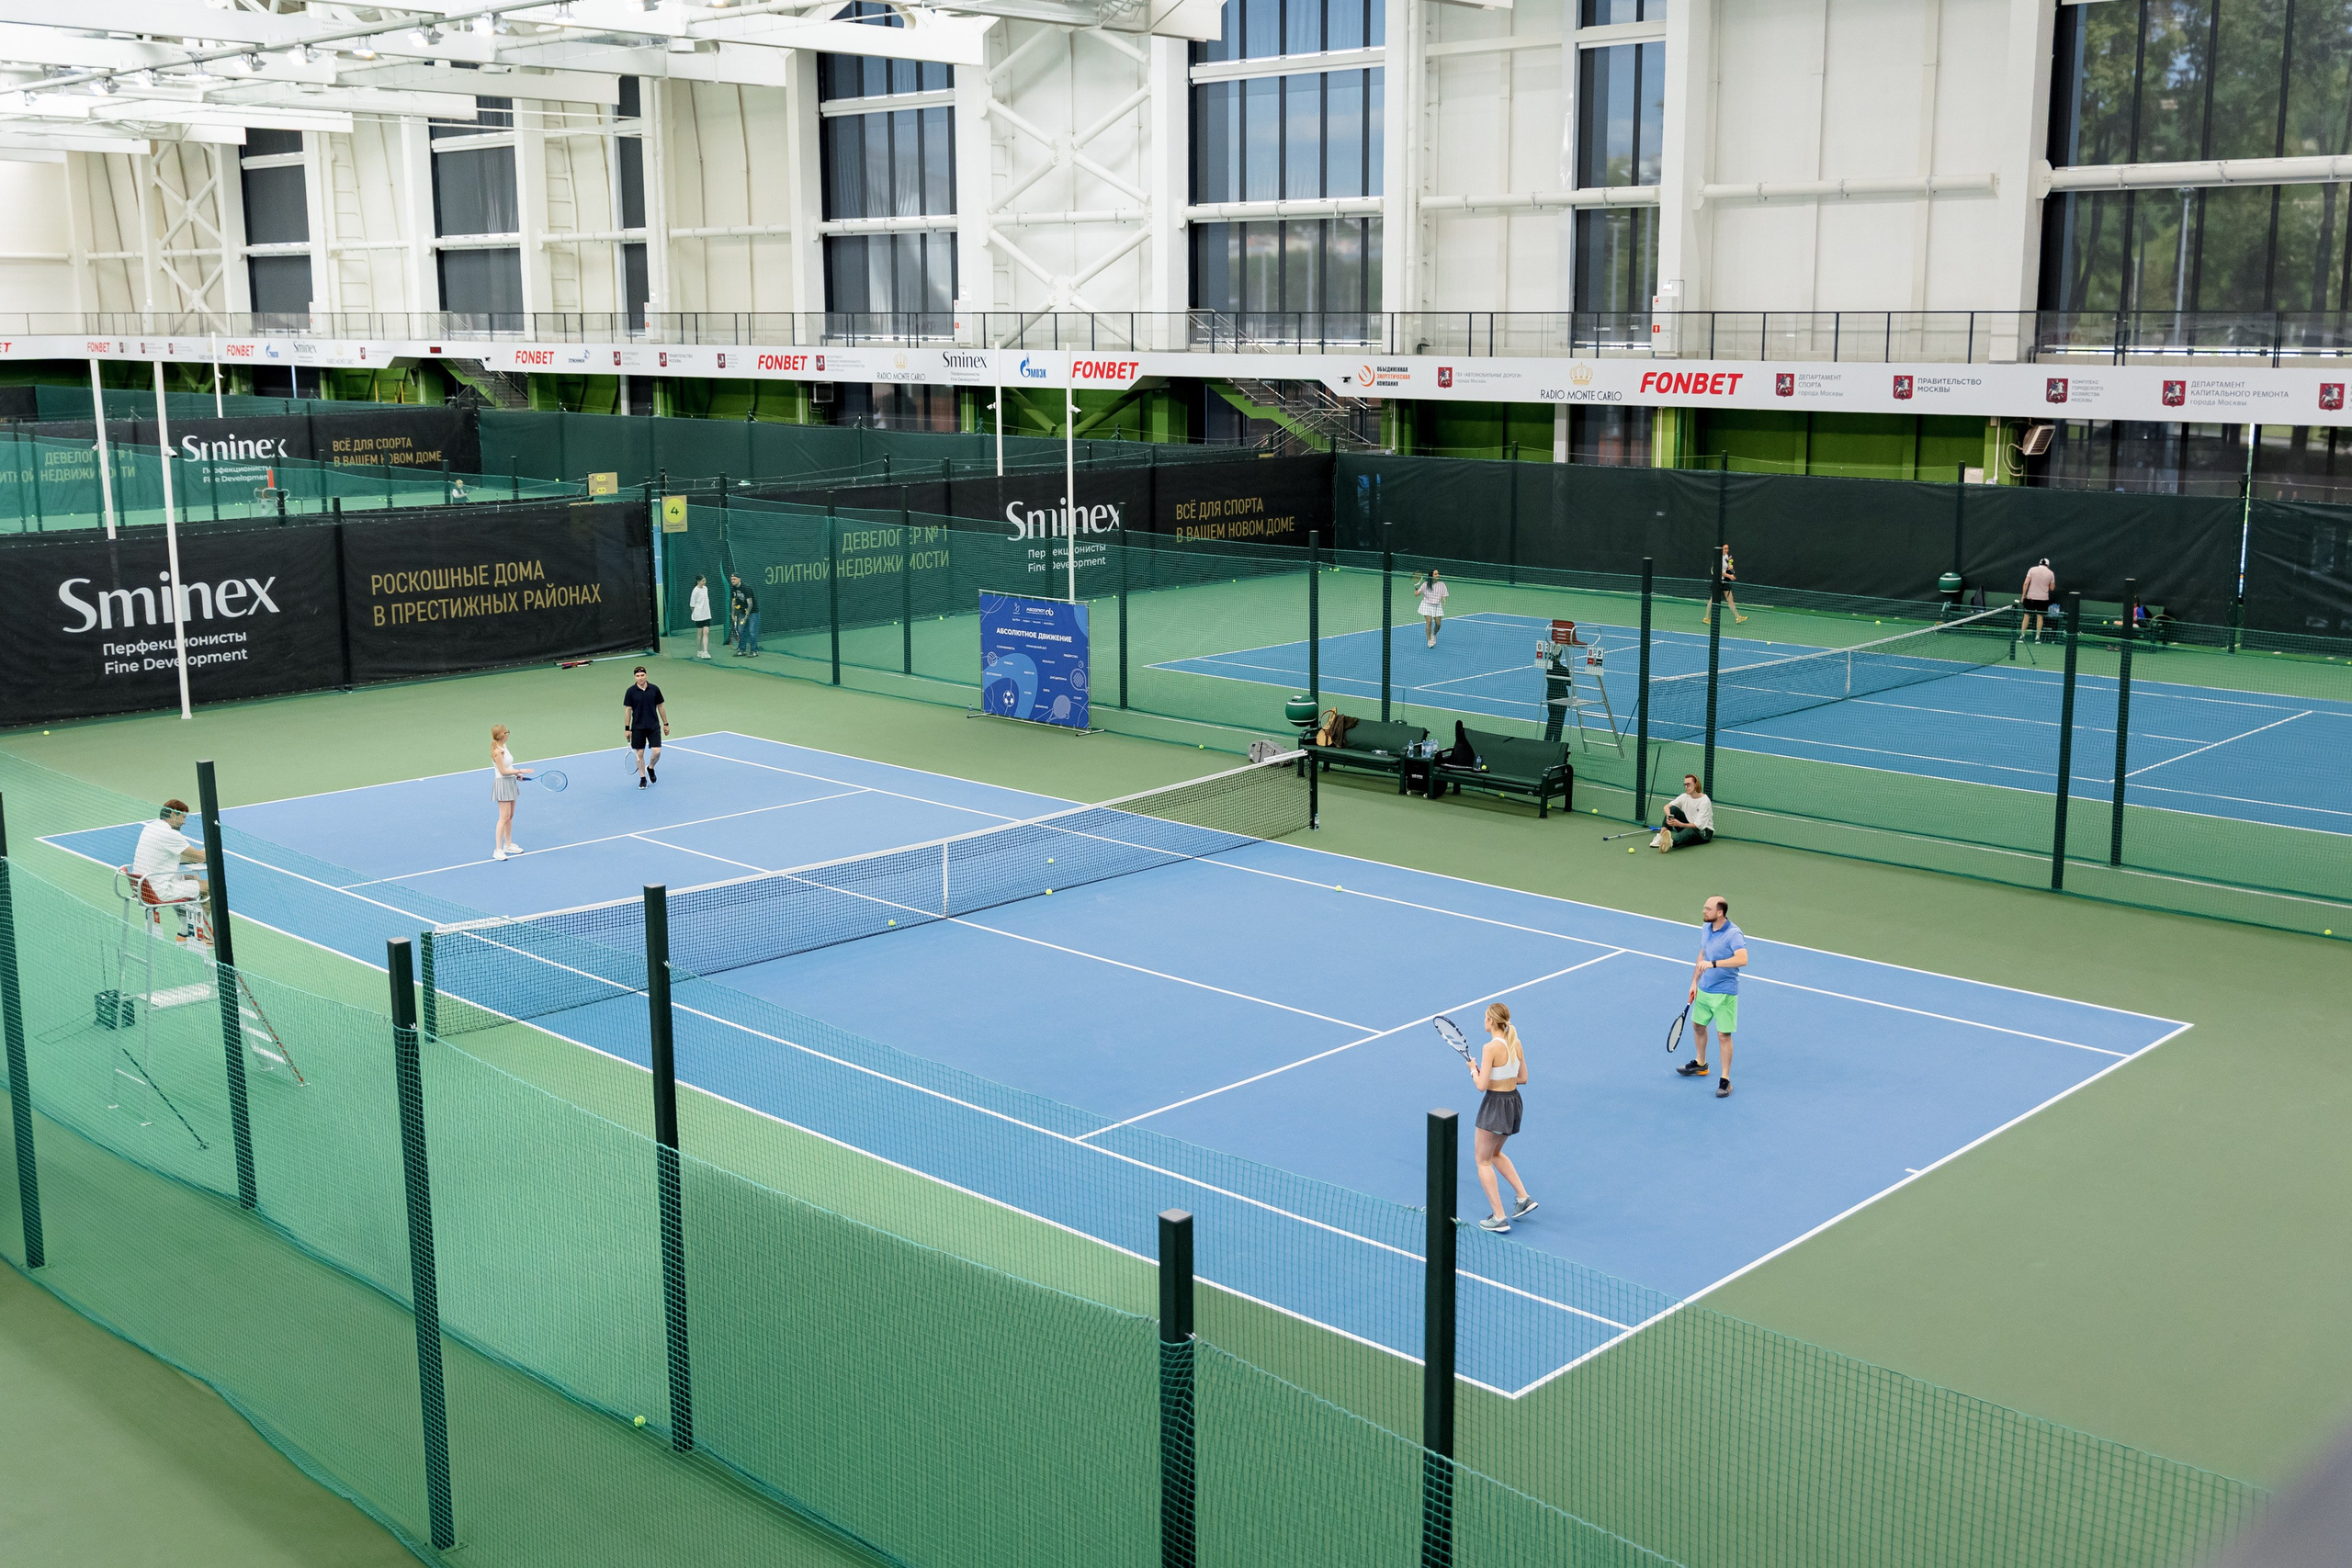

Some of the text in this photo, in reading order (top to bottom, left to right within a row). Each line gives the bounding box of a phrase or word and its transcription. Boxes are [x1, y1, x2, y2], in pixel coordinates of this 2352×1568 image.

[87, 342, 110, 353] FONBET
[226, 345, 254, 357] FONBET
[515, 350, 554, 365] FONBET
[758, 355, 808, 371] FONBET
[943, 351, 987, 368] Sminex
[877, 372, 925, 381] RADIO MONTE CARLO
[1072, 361, 1139, 380] FONBET
[1640, 372, 1743, 395] FONBET
[1540, 389, 1622, 401] RADIO MONTE CARLO
[182, 434, 288, 462] Sminex
[333, 437, 413, 452] ВСЁ ДЛЯ СПОРТА
[45, 450, 110, 466] ДЕВЕЛО
[334, 456, 340, 467] В
[343, 454, 378, 466] ВАШЕМ
[416, 450, 442, 464] ДОМЕ
[40, 466, 135, 482] НЕДВИЖИТИ
[221, 474, 270, 482] Developmen
[671, 506, 679, 515] 4
[1176, 497, 1263, 520] ВСЁ ДЛЯ СПОРТА
[1006, 497, 1119, 541] Sminex
[925, 525, 938, 543] №
[943, 525, 947, 541] 1
[1176, 516, 1295, 543] В ВАШЕМ НОВОМ ДОМЕ
[1028, 544, 1106, 559] Перекцонисты
[765, 558, 830, 585] ЭЛИТНОЙ
[1028, 557, 1106, 573] Fine eveopment
[371, 560, 545, 596] РОСКОШНЫЕ ДОМА
[58, 571, 280, 633] Sminex
[374, 583, 601, 626] В ПРЕСТИЖНЫХ РАЙОНАХ
[996, 627, 1072, 643] АБСОЛЮТНОЕ ДВИЖЕНИЕ
[104, 649, 248, 674] Fine Deveopment
